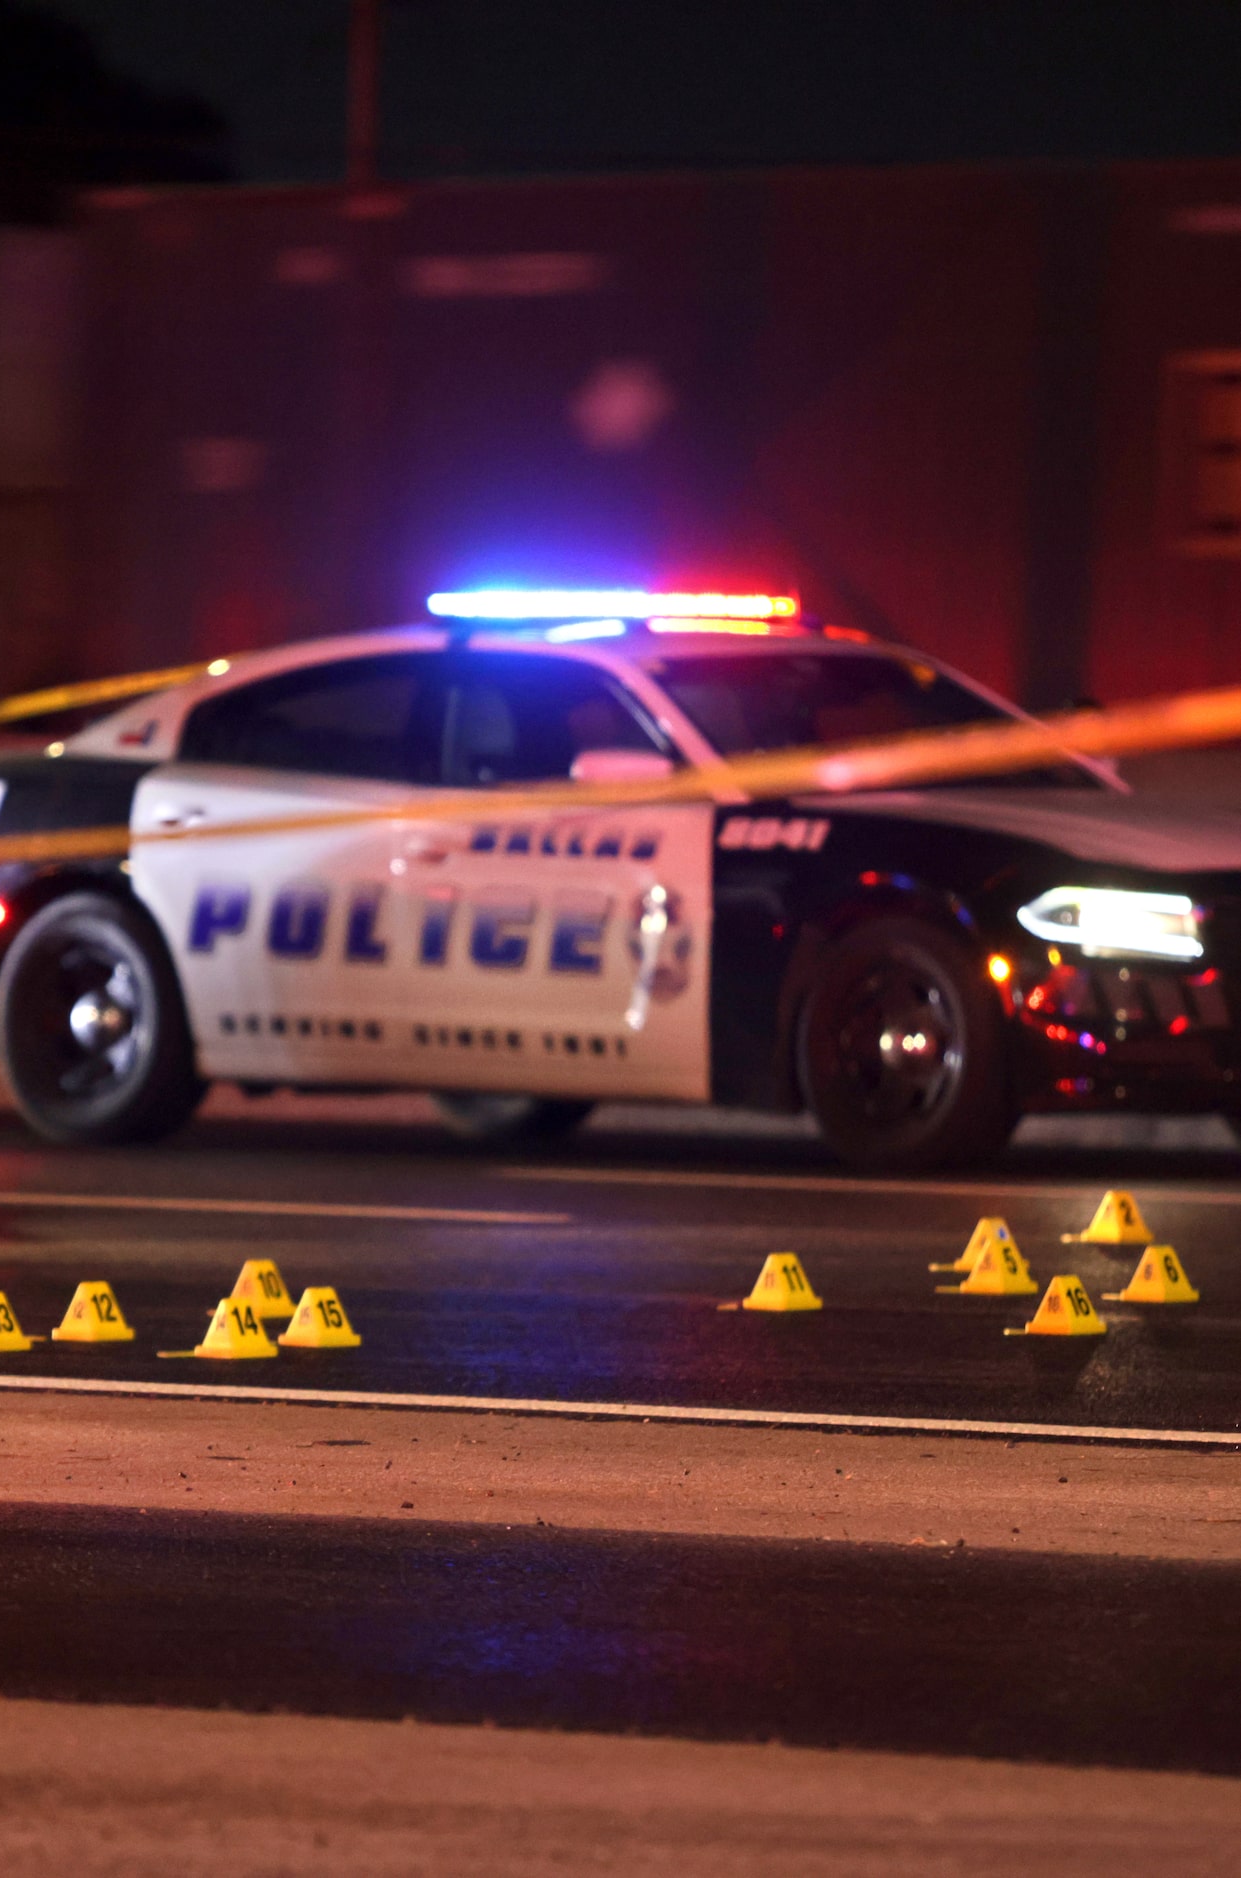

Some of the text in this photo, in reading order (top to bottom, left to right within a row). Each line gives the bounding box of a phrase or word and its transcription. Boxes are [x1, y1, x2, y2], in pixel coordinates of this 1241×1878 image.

[187, 881, 616, 976] POLICE
[1119, 1200, 1135, 1227] 2
[1003, 1247, 1018, 1275] 5
[1163, 1255, 1179, 1283] 6
[258, 1271, 281, 1299] 10
[782, 1265, 805, 1292] 11
[91, 1293, 118, 1322] 12
[317, 1300, 343, 1329] 15
[1066, 1287, 1091, 1317] 16
[232, 1305, 258, 1335] 14
